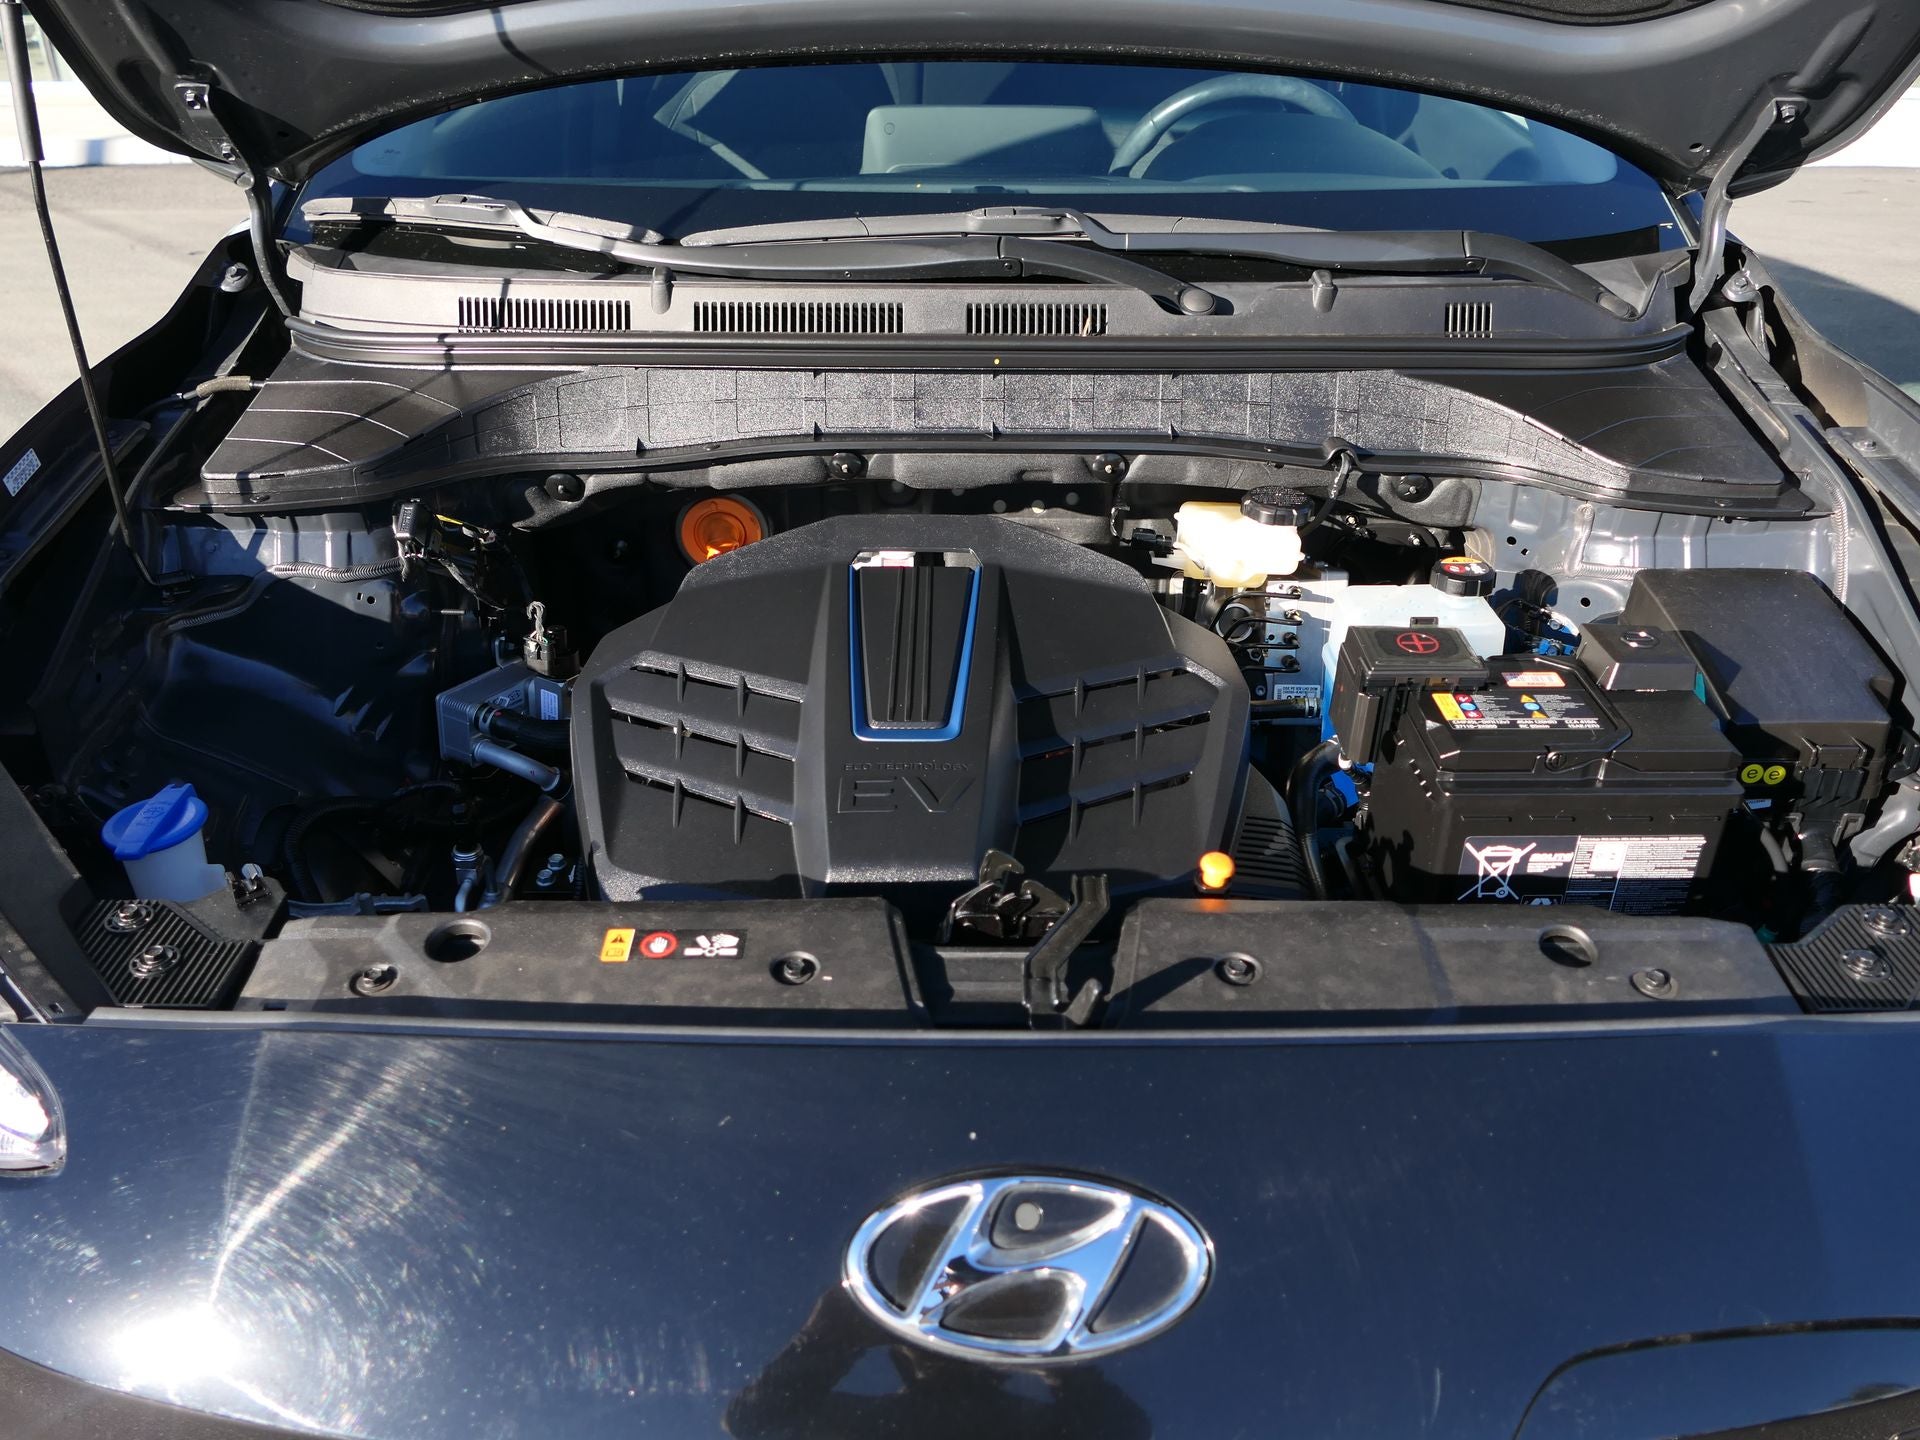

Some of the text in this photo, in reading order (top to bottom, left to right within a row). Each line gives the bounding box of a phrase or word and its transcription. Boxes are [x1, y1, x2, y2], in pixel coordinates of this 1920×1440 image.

[844, 762, 970, 772] ECO TECHNOLOGY
[1747, 768, 1780, 780] e e
[838, 776, 976, 813] EV
